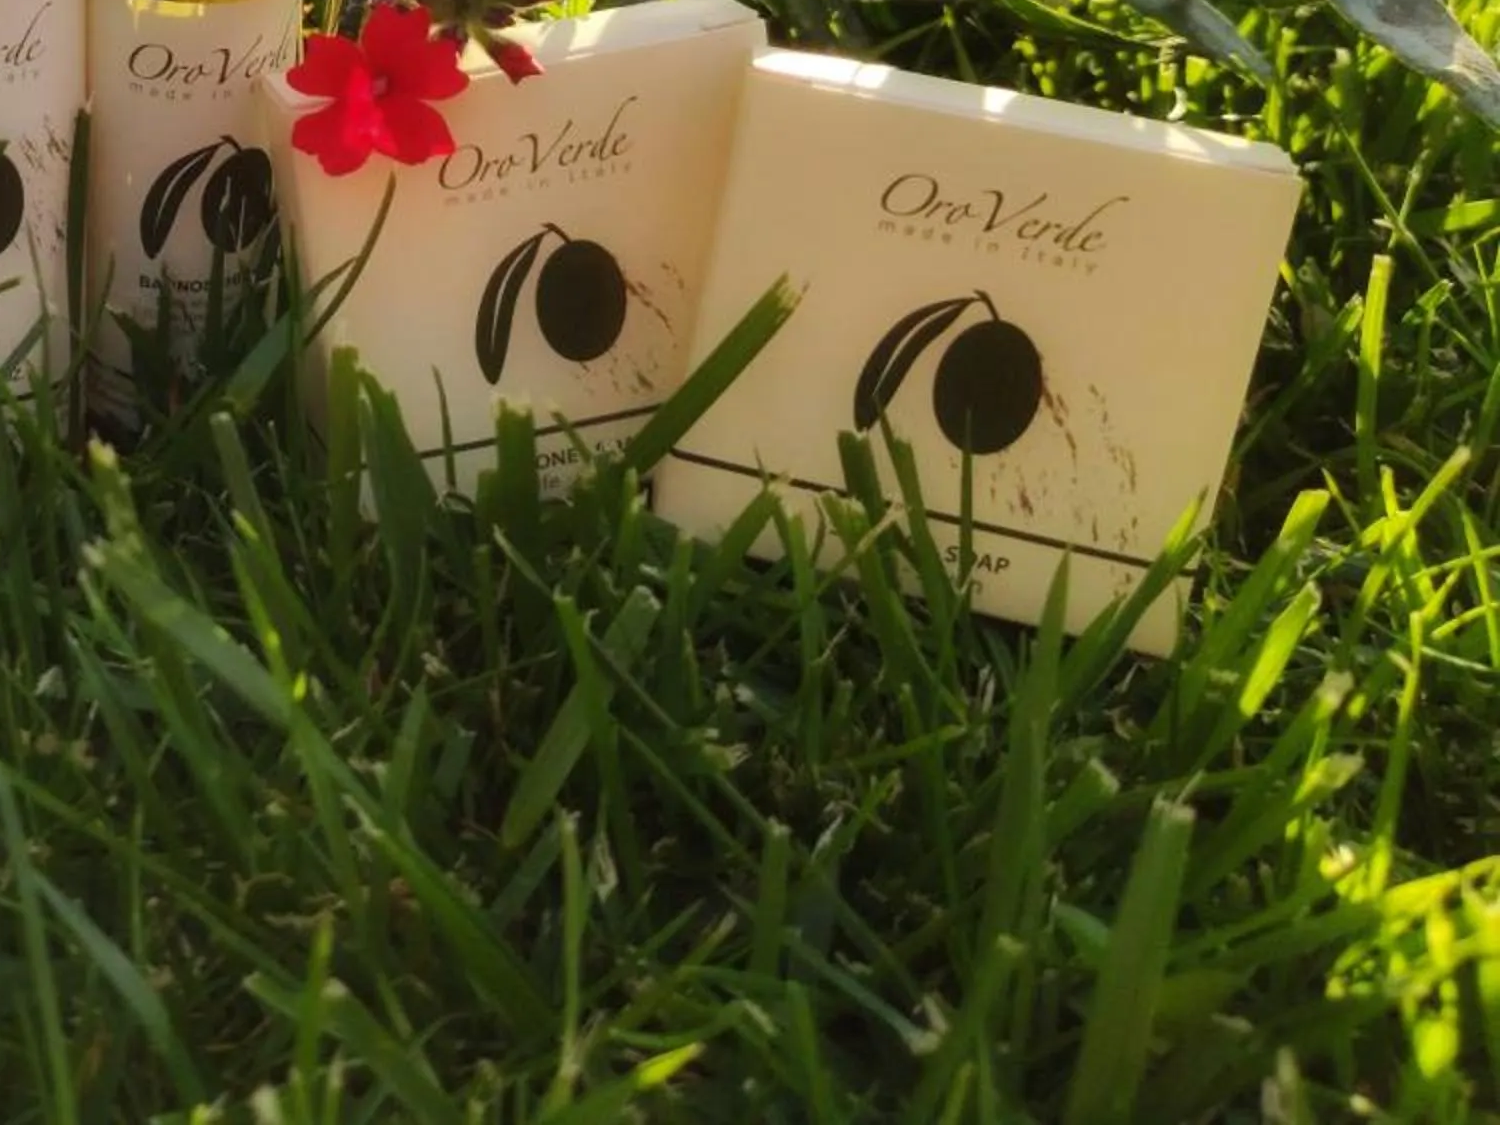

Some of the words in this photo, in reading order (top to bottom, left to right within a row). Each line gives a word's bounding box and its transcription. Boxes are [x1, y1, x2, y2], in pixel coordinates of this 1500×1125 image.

[128, 43, 212, 85] Oro
[438, 144, 525, 191] Oro
[517, 96, 637, 175] Verde
[880, 174, 978, 225] Oro
[982, 190, 1131, 254] Verde
